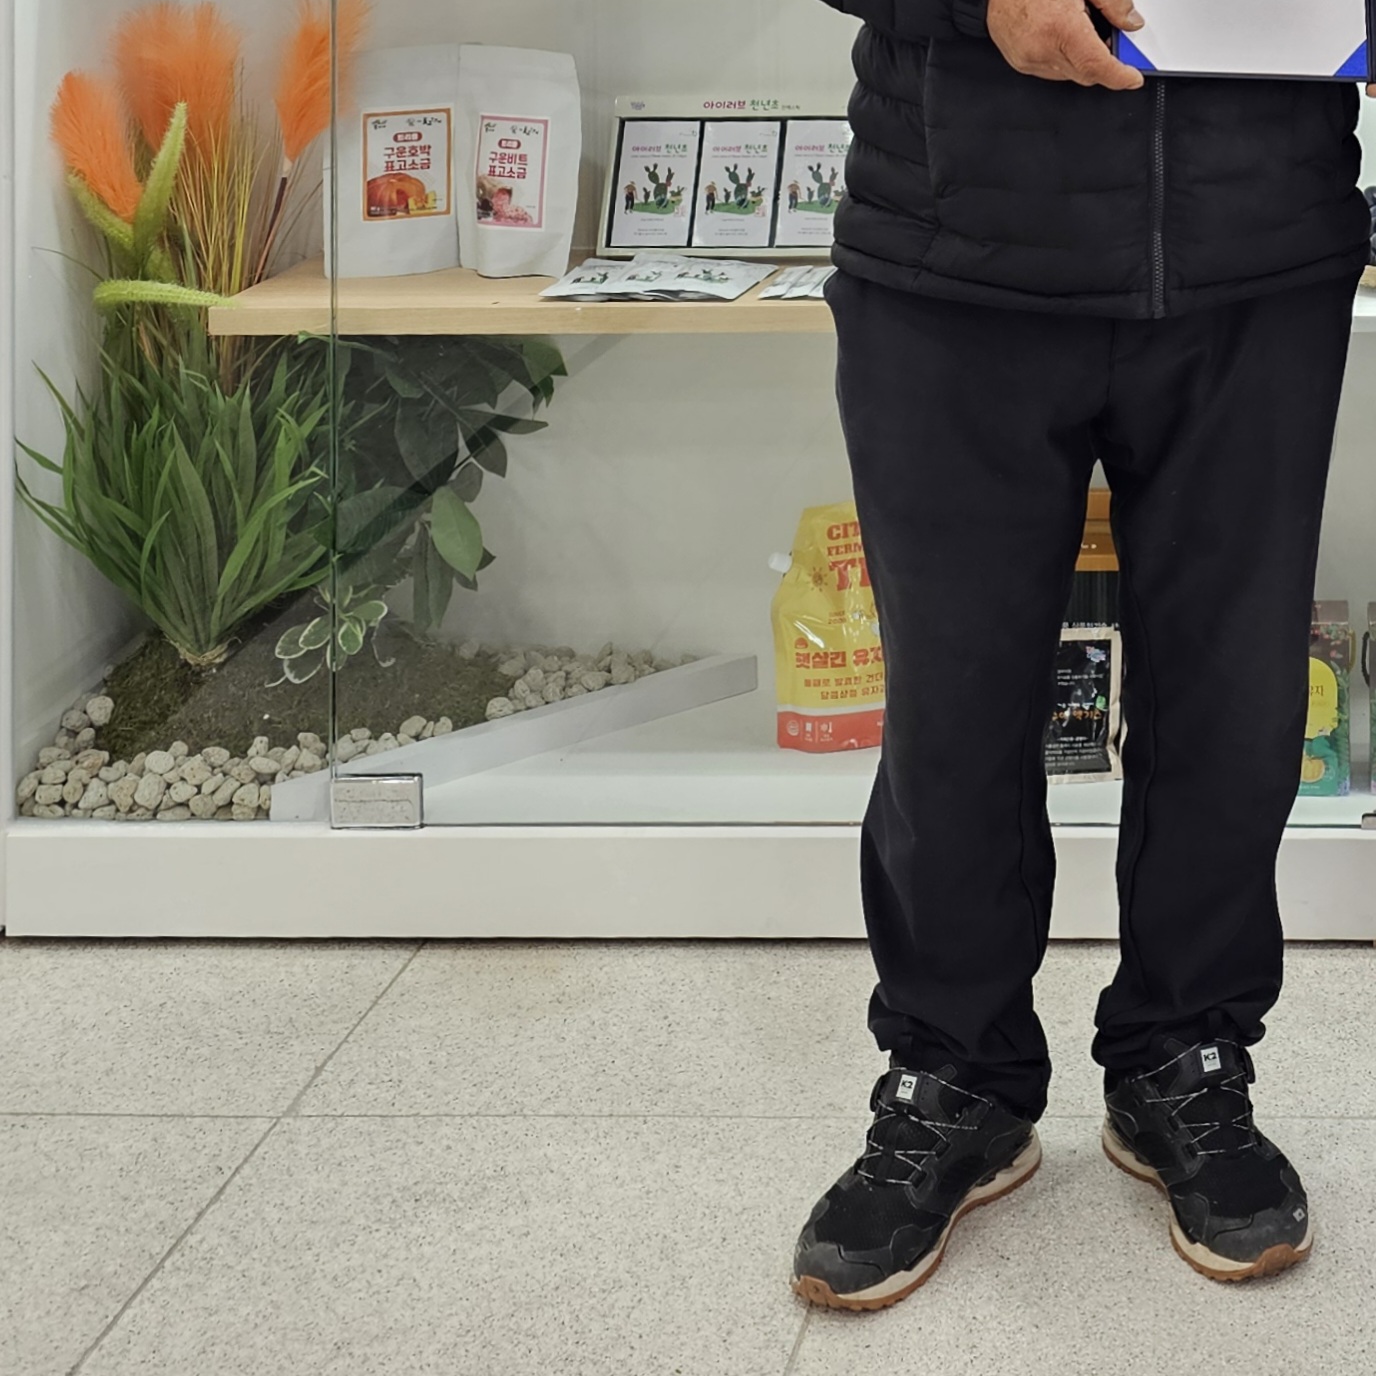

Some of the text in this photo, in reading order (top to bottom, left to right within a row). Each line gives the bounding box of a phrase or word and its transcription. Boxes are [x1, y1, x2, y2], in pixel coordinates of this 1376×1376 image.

[703, 99, 779, 111] 아이러브 천년초
[383, 144, 431, 159] 구운호박
[664, 143, 688, 153] 천년초
[712, 143, 768, 153] 아이러브 천년초
[794, 144, 825, 152] 아이러브
[489, 151, 528, 166] 구운비트
[383, 158, 431, 172] 표고소금
[488, 165, 527, 179] 표고소금
[1203, 1052, 1217, 1062] K2
[901, 1079, 913, 1090] K2
